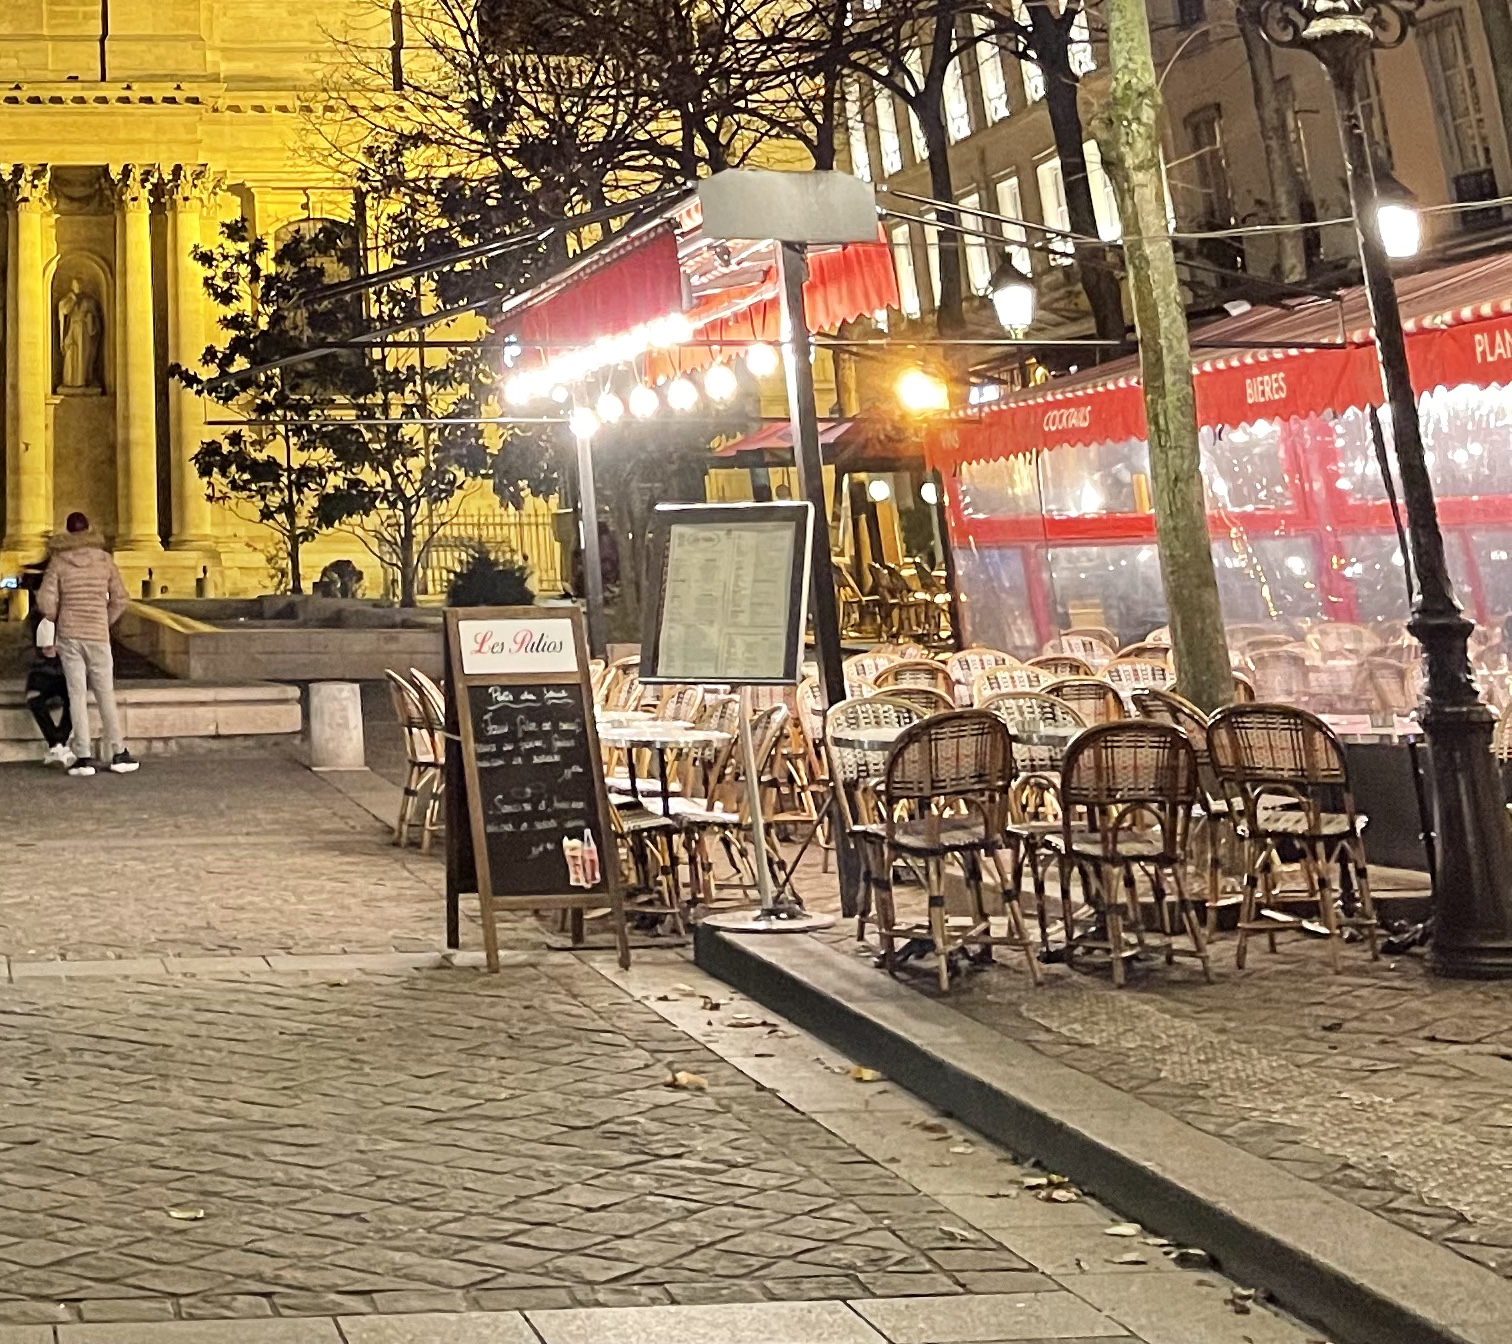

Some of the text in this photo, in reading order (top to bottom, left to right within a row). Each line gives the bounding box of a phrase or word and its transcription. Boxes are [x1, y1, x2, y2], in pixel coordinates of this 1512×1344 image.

[1245, 372, 1287, 404] BIERES
[1043, 405, 1092, 432] COCKTAILS
[470, 630, 505, 655] Les
